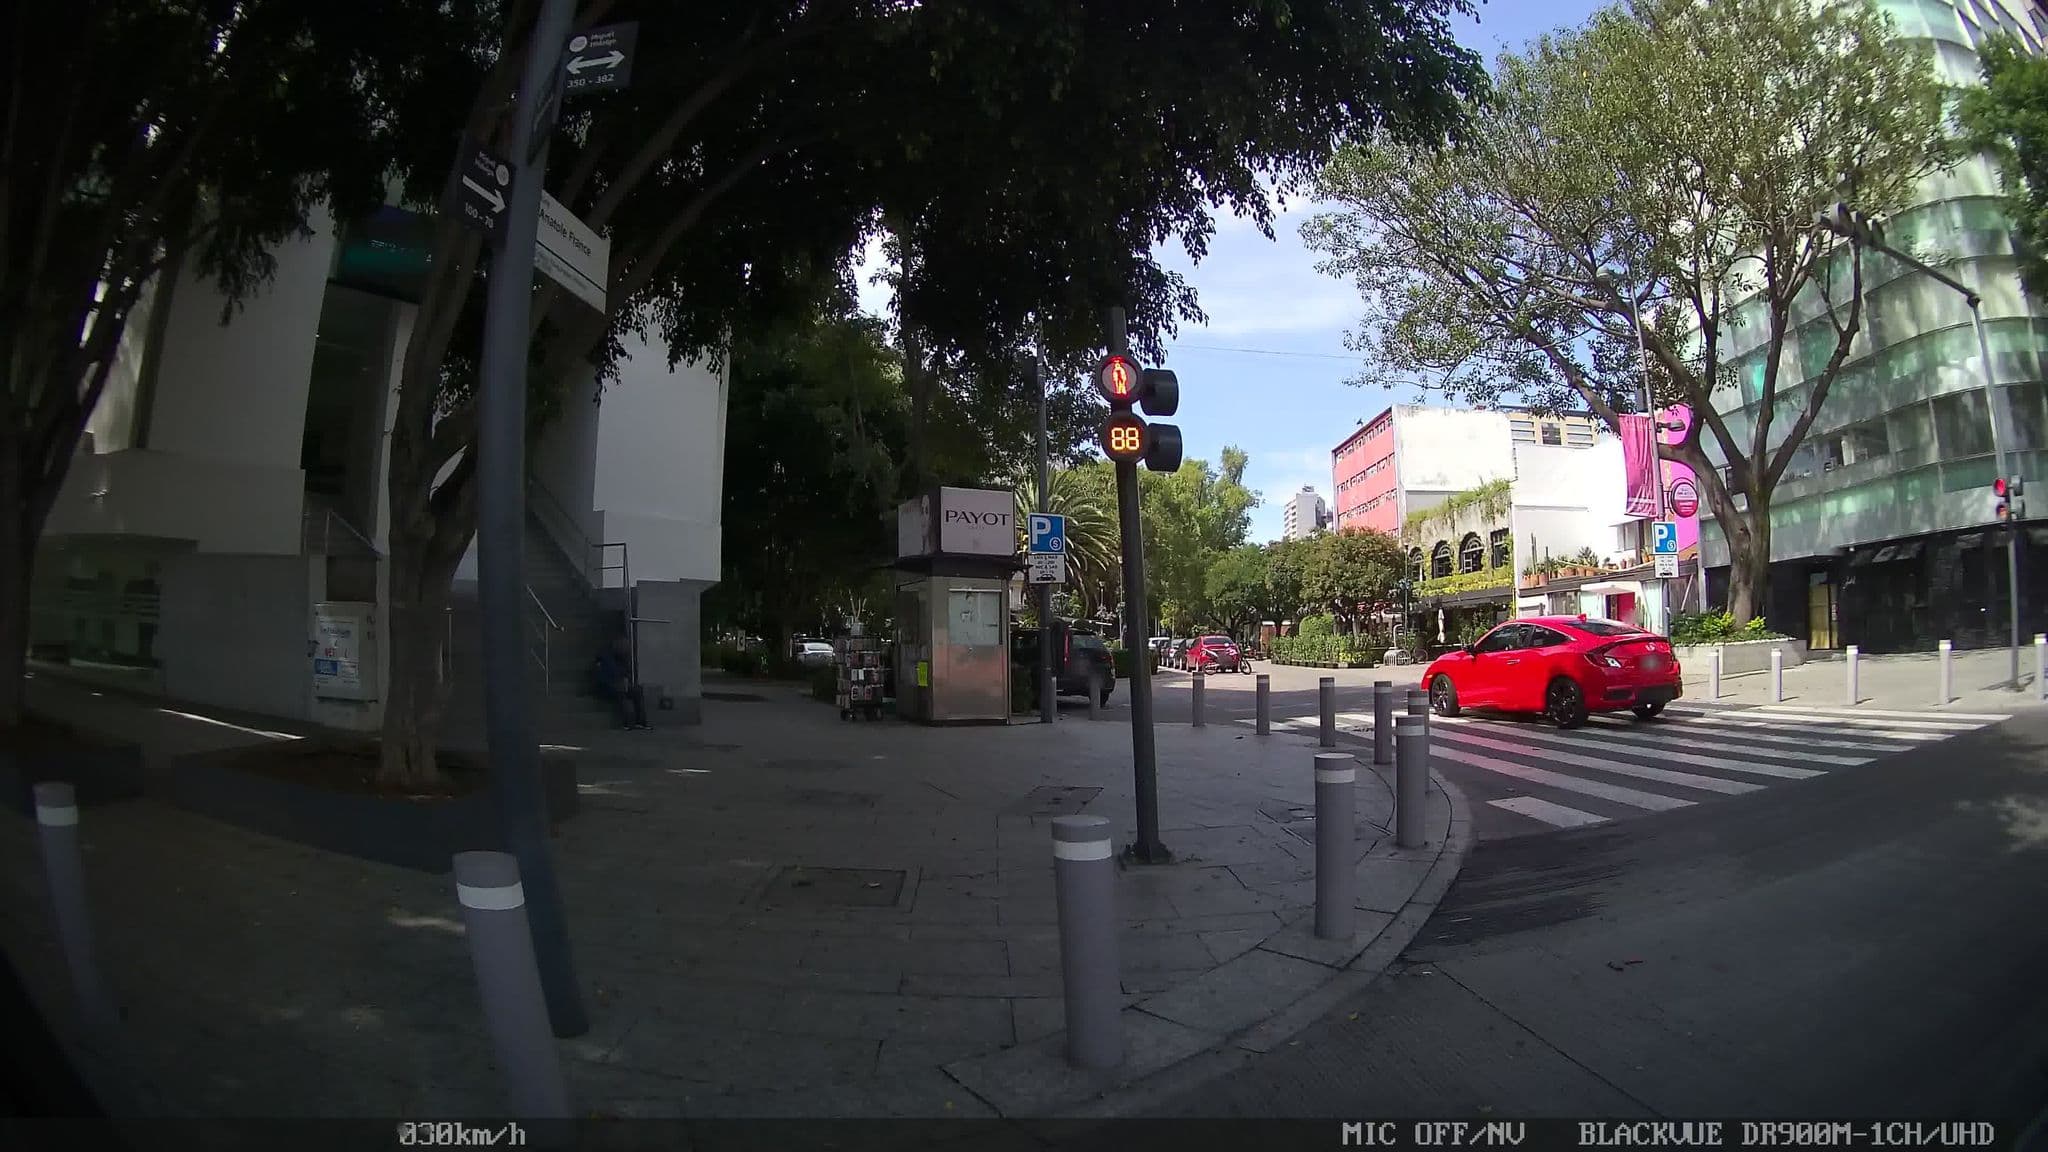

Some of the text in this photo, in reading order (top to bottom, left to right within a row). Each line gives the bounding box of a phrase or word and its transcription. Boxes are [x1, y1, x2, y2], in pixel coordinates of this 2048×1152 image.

[567, 78, 586, 88] 350
[595, 73, 615, 84] 382
[537, 208, 592, 257] Anatole France
[1111, 427, 1140, 450] 88
[945, 510, 1010, 526] PAYOT
[1031, 516, 1051, 545] P
[1655, 525, 1668, 547] P
